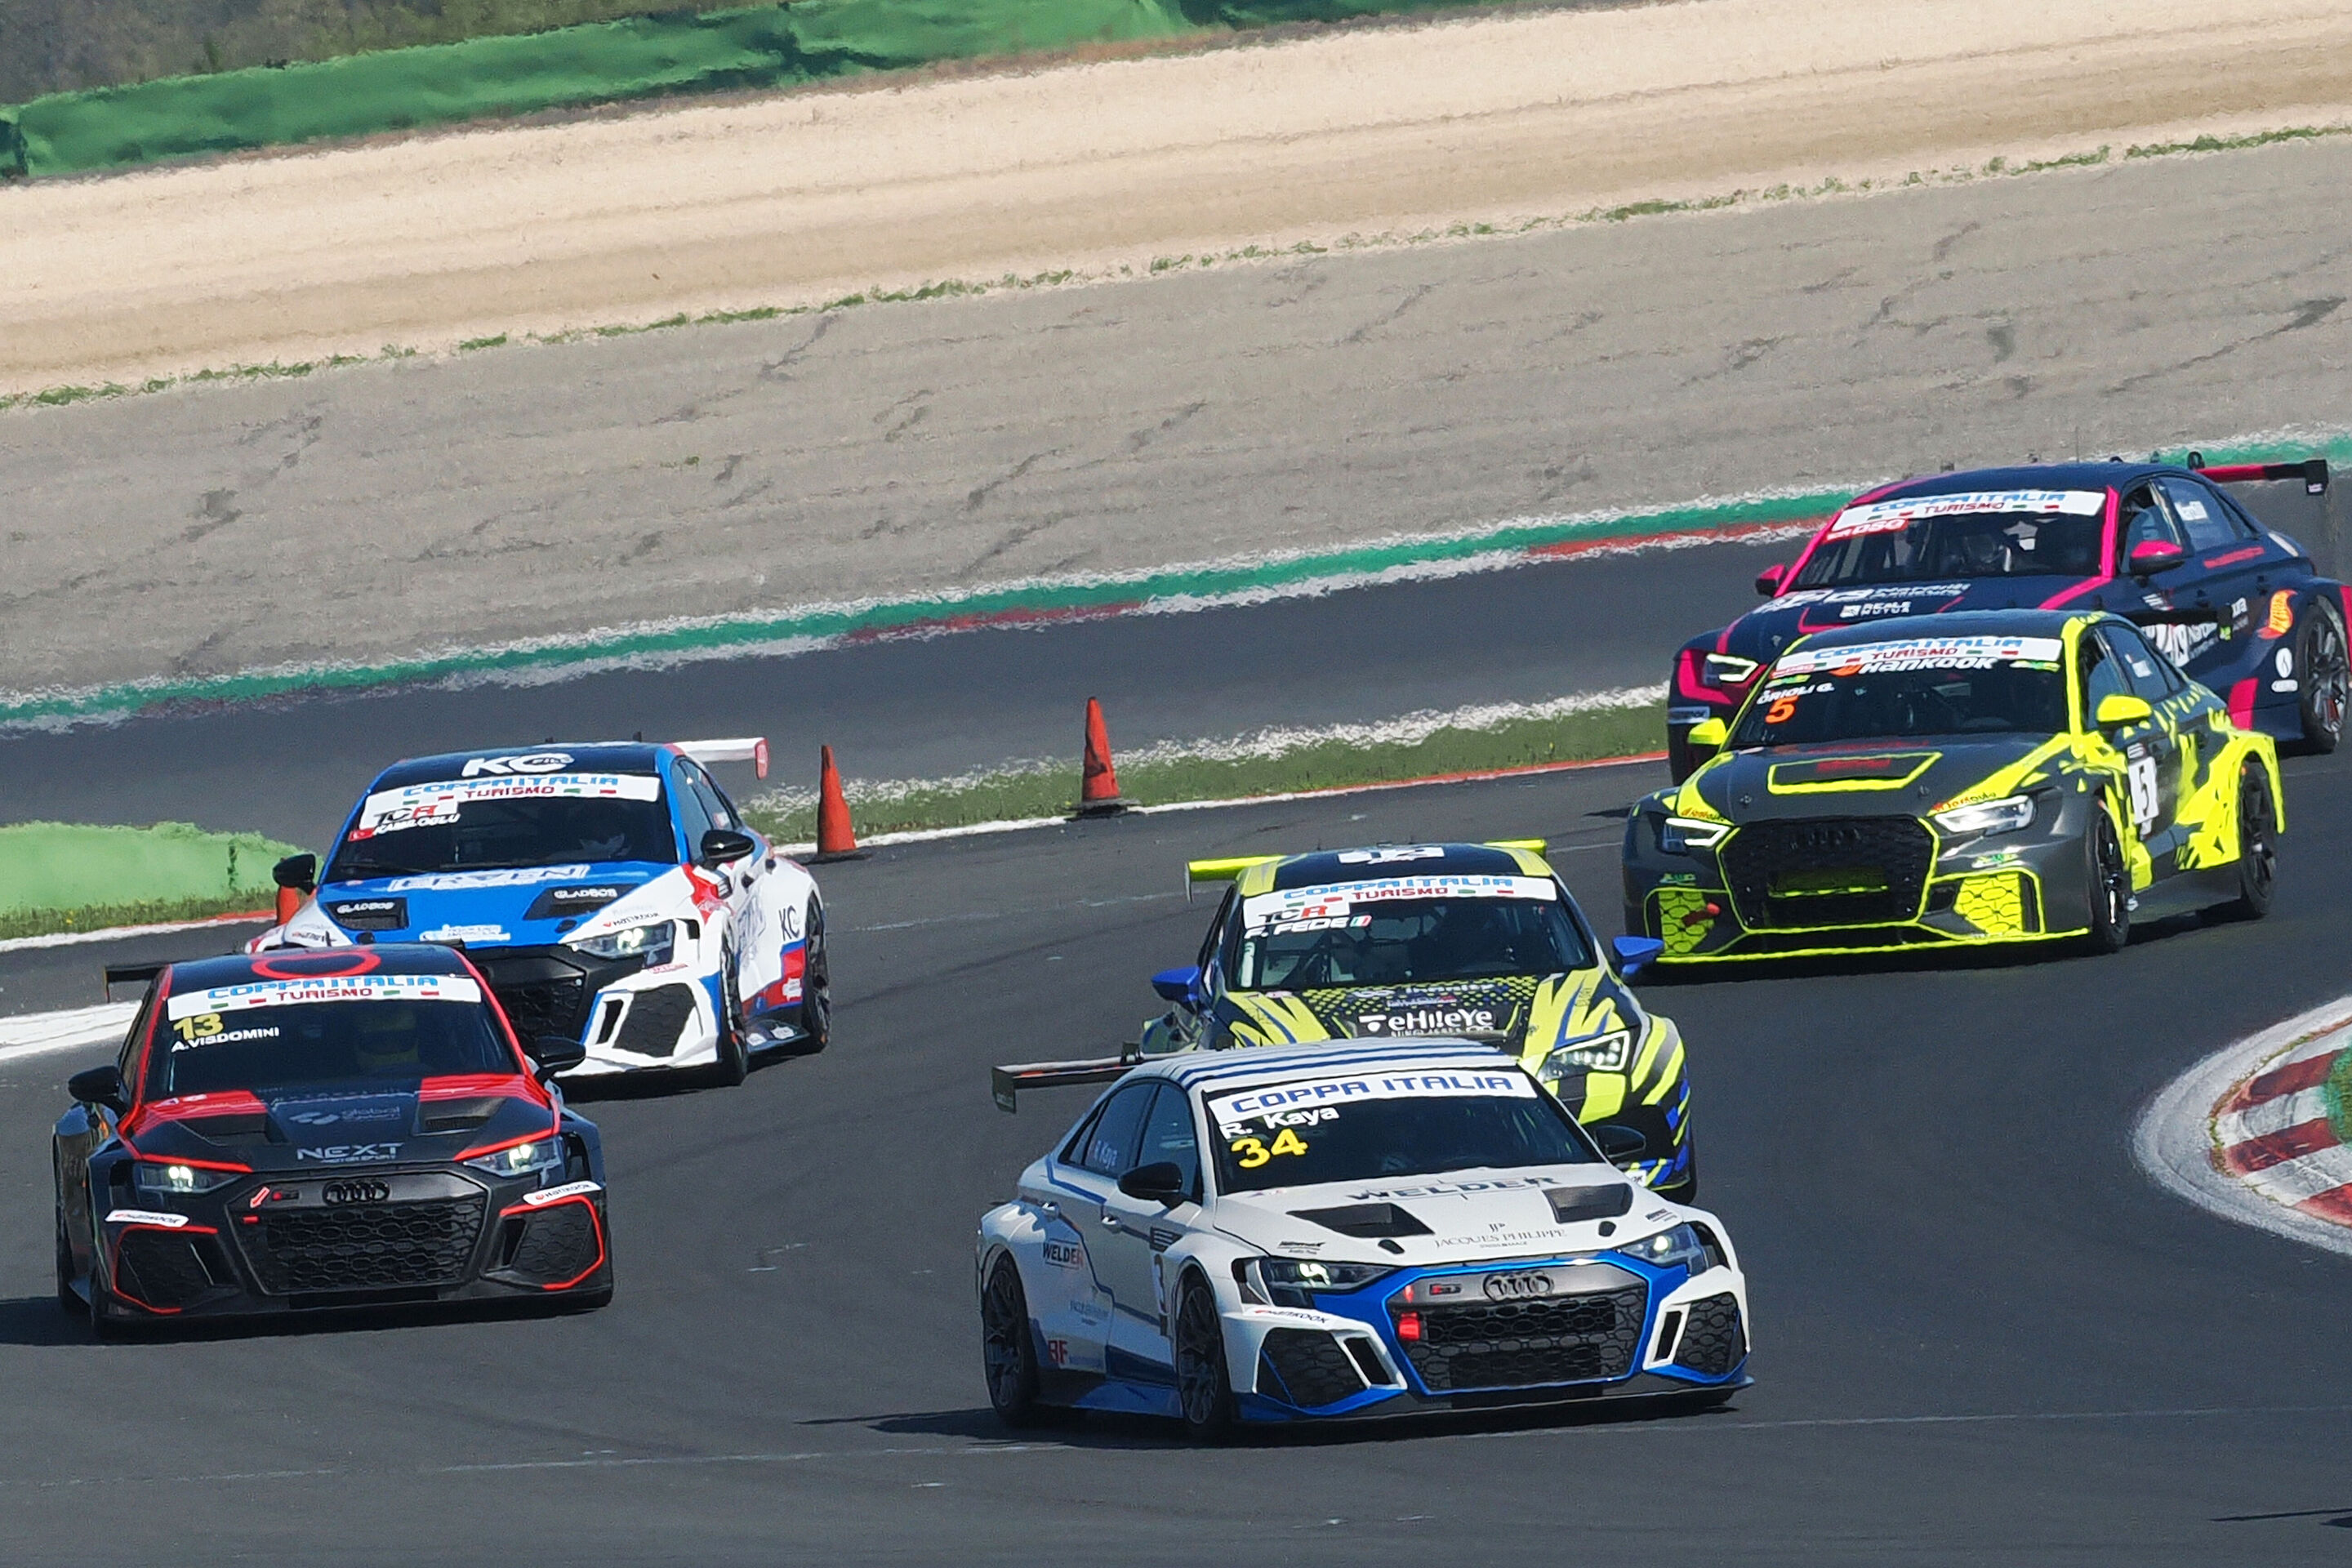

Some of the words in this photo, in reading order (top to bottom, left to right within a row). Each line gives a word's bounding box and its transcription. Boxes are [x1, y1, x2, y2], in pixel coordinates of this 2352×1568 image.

[1924, 502, 2005, 514] TURISMO
[1871, 648, 1958, 660] TURISMO
[1765, 694, 1799, 724] 5
[465, 786, 555, 799] TURISMO
[1352, 887, 1449, 900] TURISMO
[1258, 905, 1328, 924] TCR
[1244, 926, 1269, 940] F.
[1273, 916, 1350, 936] FEDE
[276, 988, 373, 1002] TURISMO
[172, 1013, 224, 1041] 13
[1232, 1081, 1371, 1113] COPPA
[1386, 1075, 1513, 1092] ITALIA
[1219, 1123, 1253, 1140] R.
[1265, 1107, 1340, 1130] Kaya
[296, 1143, 404, 1160] NEXT
[1230, 1128, 1309, 1169] 34
[1348, 1176, 1561, 1200] WELDER
[1435, 1232, 1499, 1249] JACQUES
[1503, 1228, 1569, 1241] PHILIPPE
